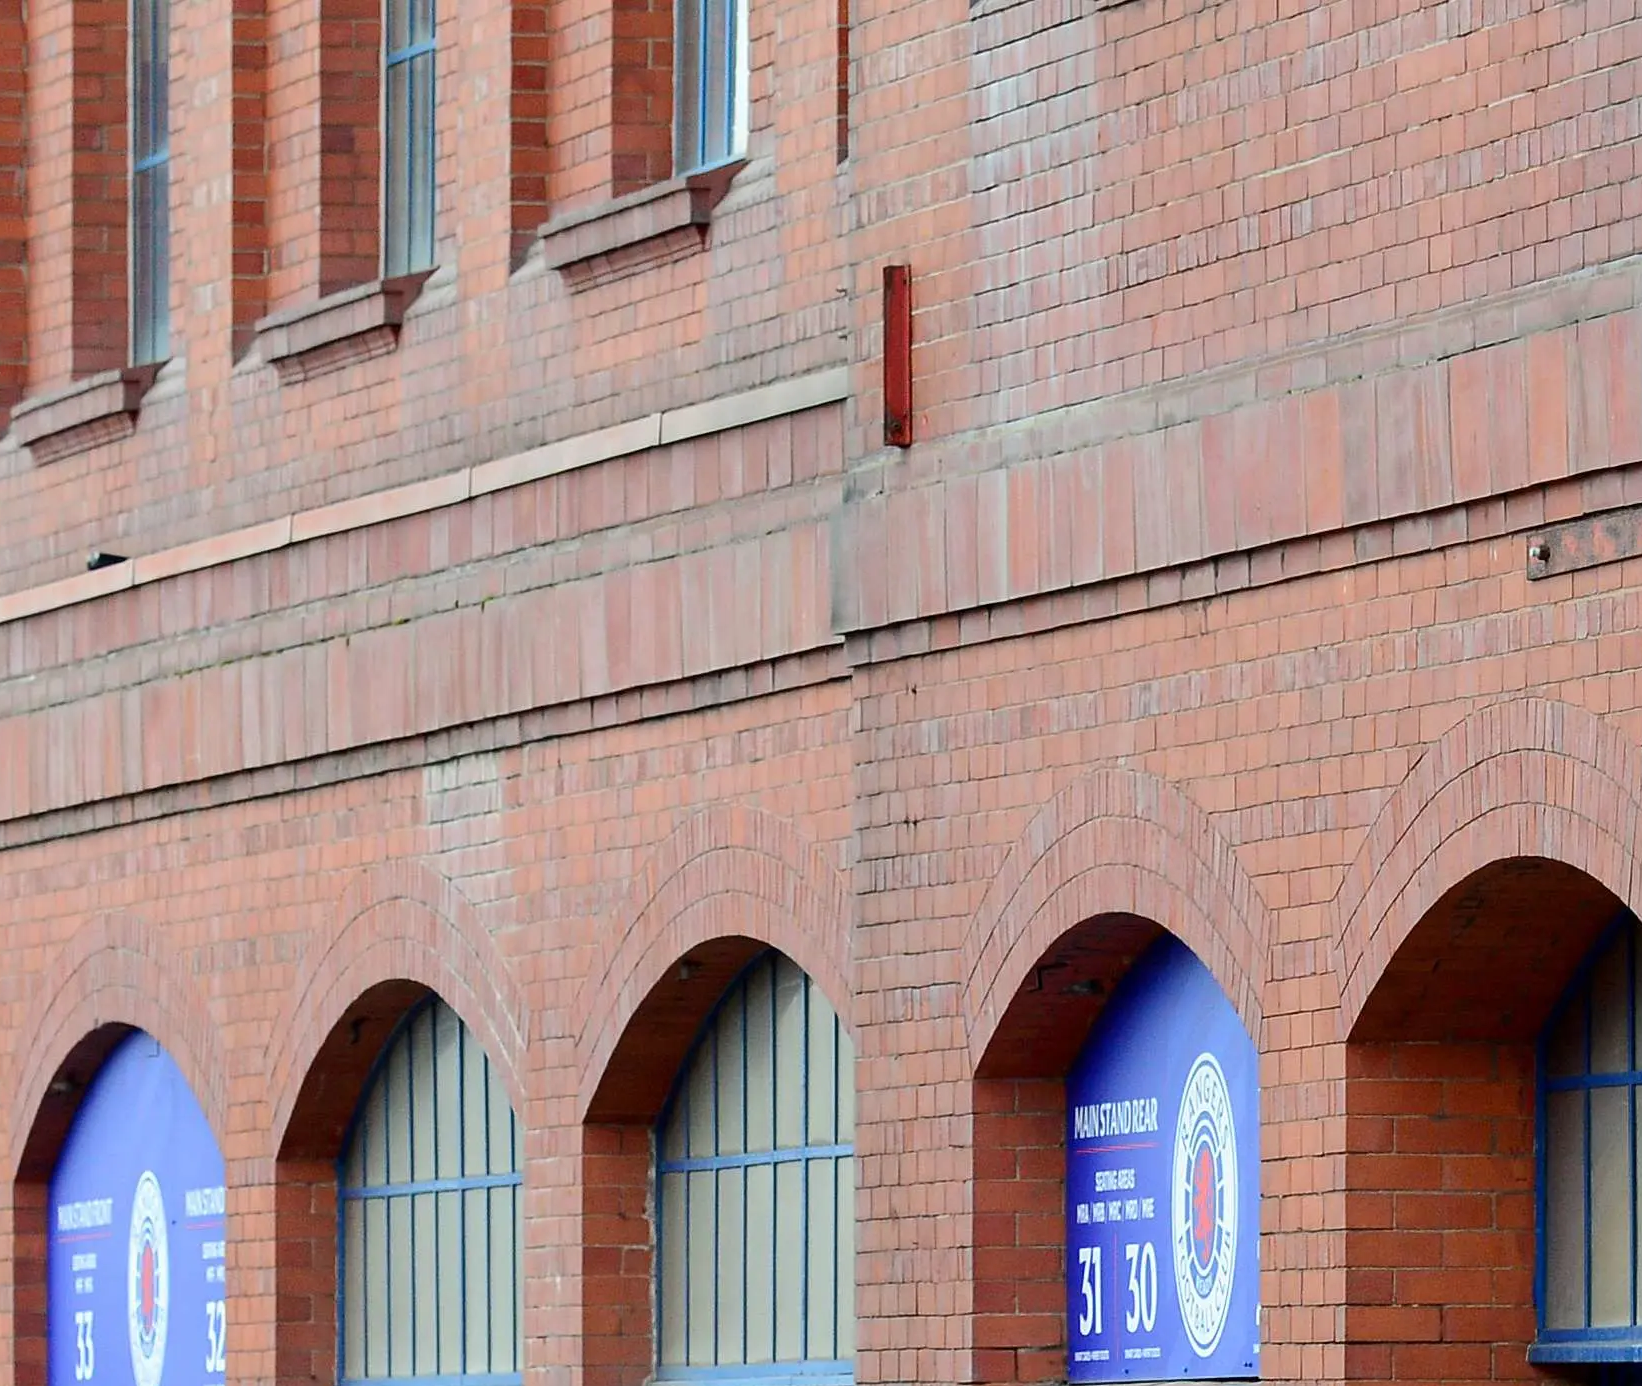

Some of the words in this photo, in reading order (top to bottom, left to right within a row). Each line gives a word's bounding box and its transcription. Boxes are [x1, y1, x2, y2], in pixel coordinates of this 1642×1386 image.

[1074, 1104, 1099, 1139] MAIN
[1100, 1101, 1132, 1137] STAND
[1132, 1097, 1158, 1133] REAR
[1079, 1246, 1102, 1336] 31
[1125, 1241, 1158, 1333] 30
[75, 1310, 94, 1380] 33
[205, 1300, 226, 1373] 32
